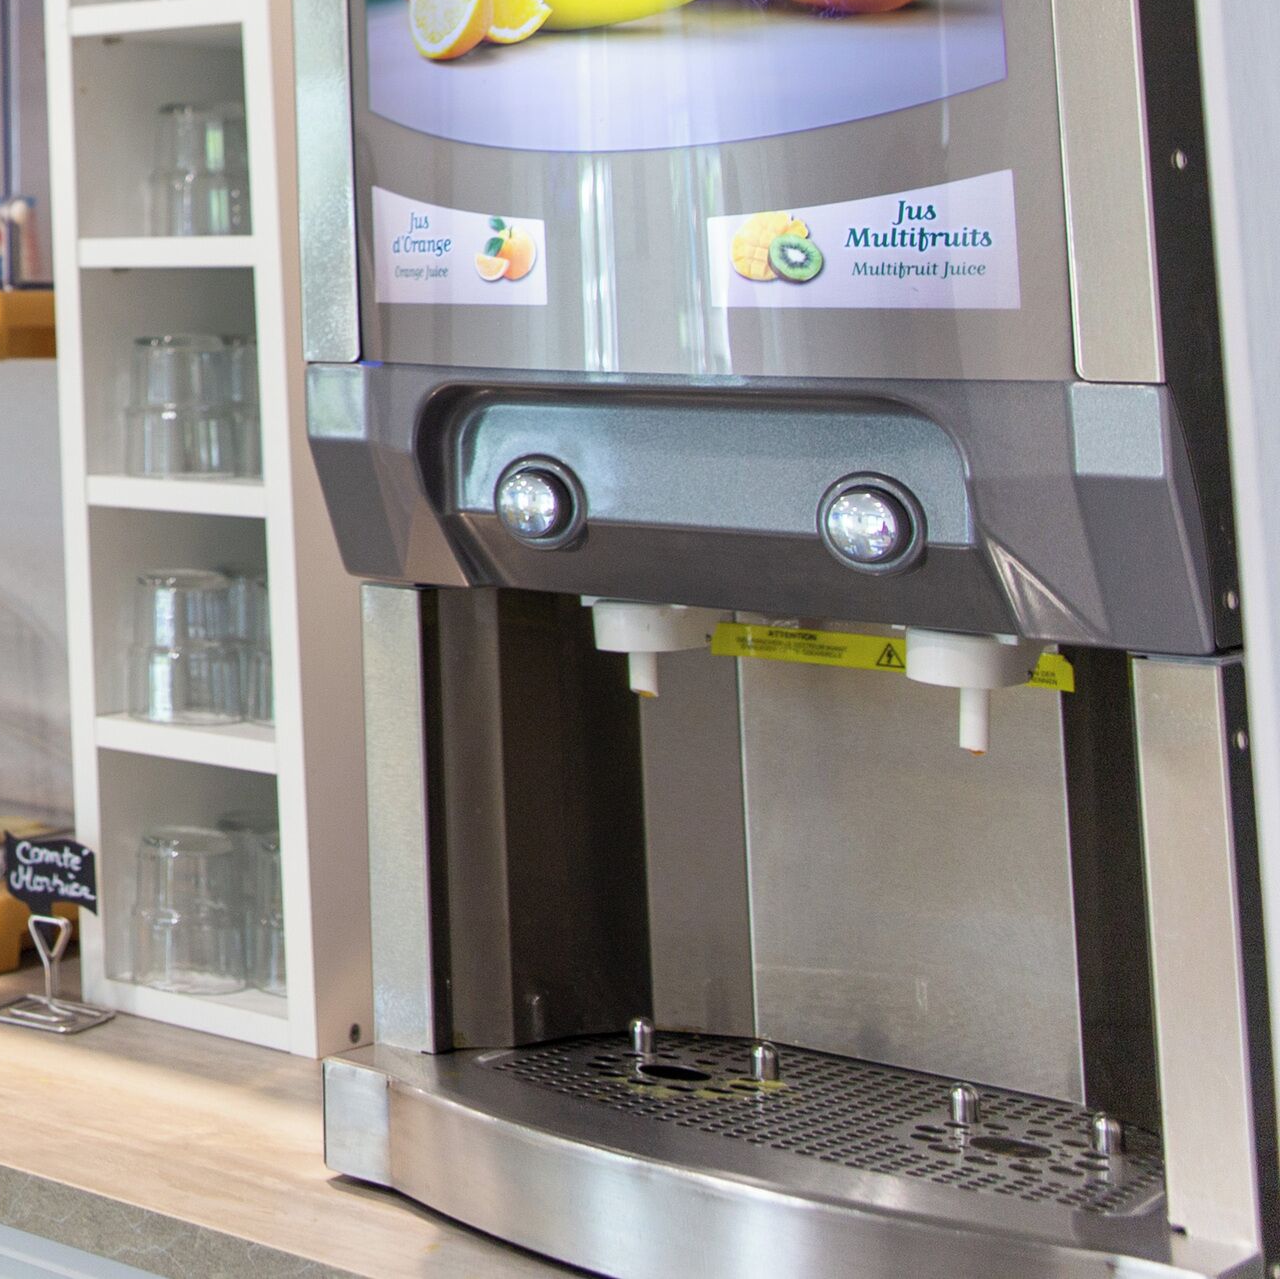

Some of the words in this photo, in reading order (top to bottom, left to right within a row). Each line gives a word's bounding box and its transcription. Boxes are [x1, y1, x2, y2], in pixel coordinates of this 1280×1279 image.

[409, 212, 429, 234] Jus
[892, 200, 937, 226] Jus
[393, 236, 451, 257] d'Orange
[844, 226, 993, 252] Multifruits
[851, 261, 939, 279] Multifruit
[940, 261, 986, 279] Juice
[15, 840, 90, 871] Comté
